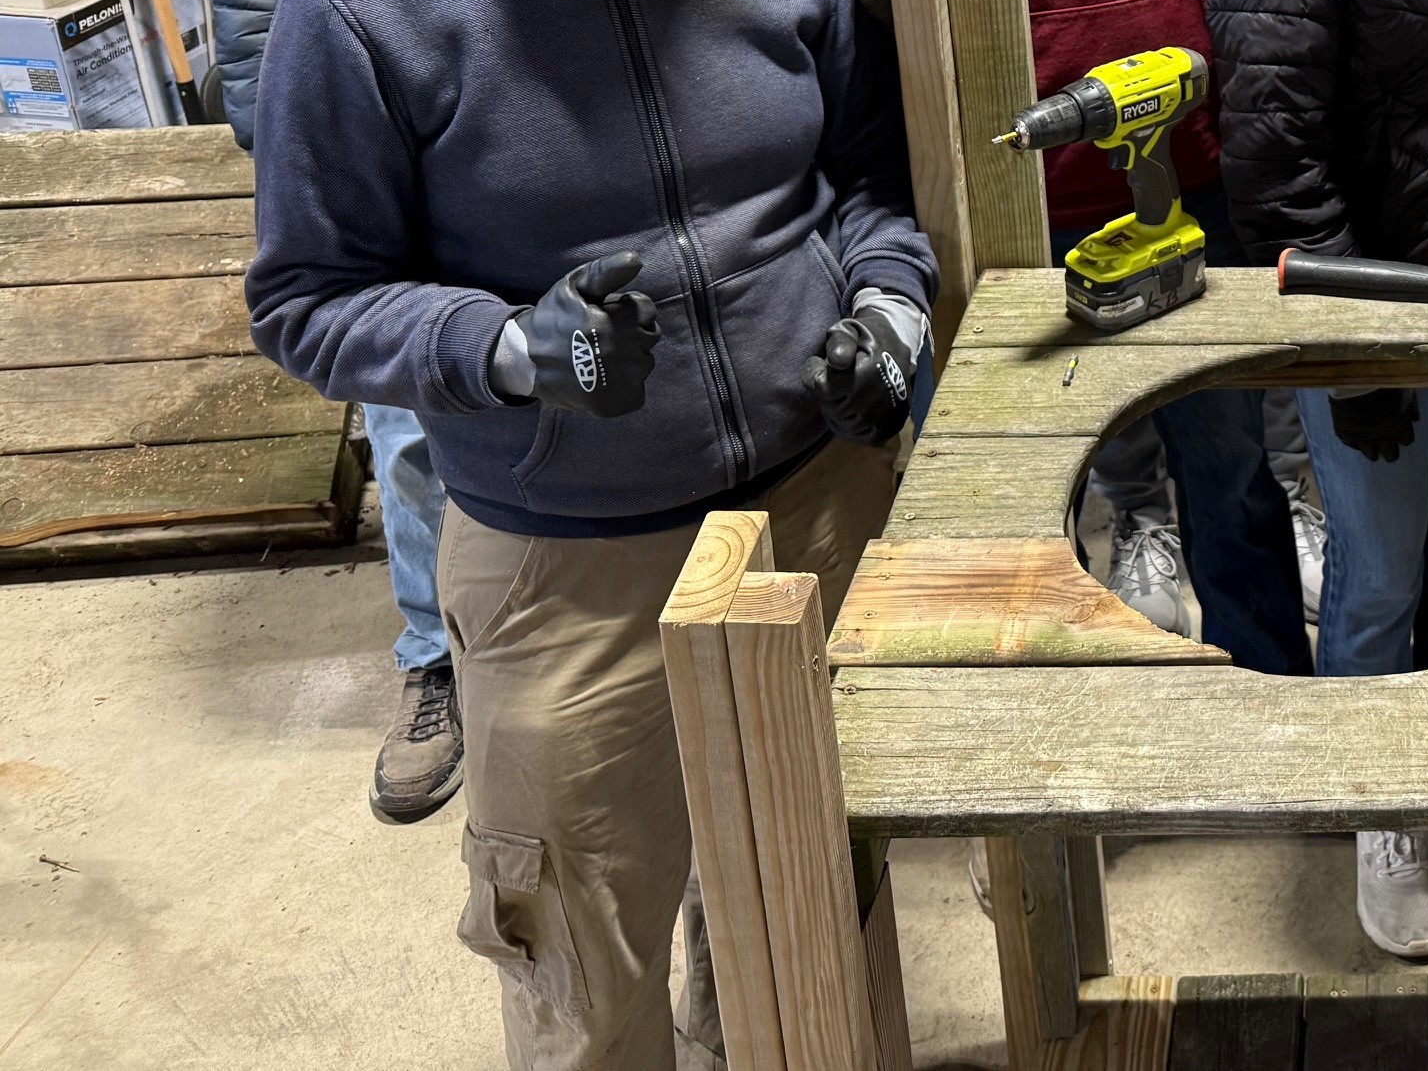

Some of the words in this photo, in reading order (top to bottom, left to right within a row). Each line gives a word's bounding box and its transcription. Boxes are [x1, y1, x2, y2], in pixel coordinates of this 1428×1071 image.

[73, 34, 128, 67] Through-the-Wa
[76, 66, 88, 79] Air
[89, 44, 132, 70] Condition
[1123, 99, 1158, 120] RYOBI
[573, 338, 596, 384] RW
